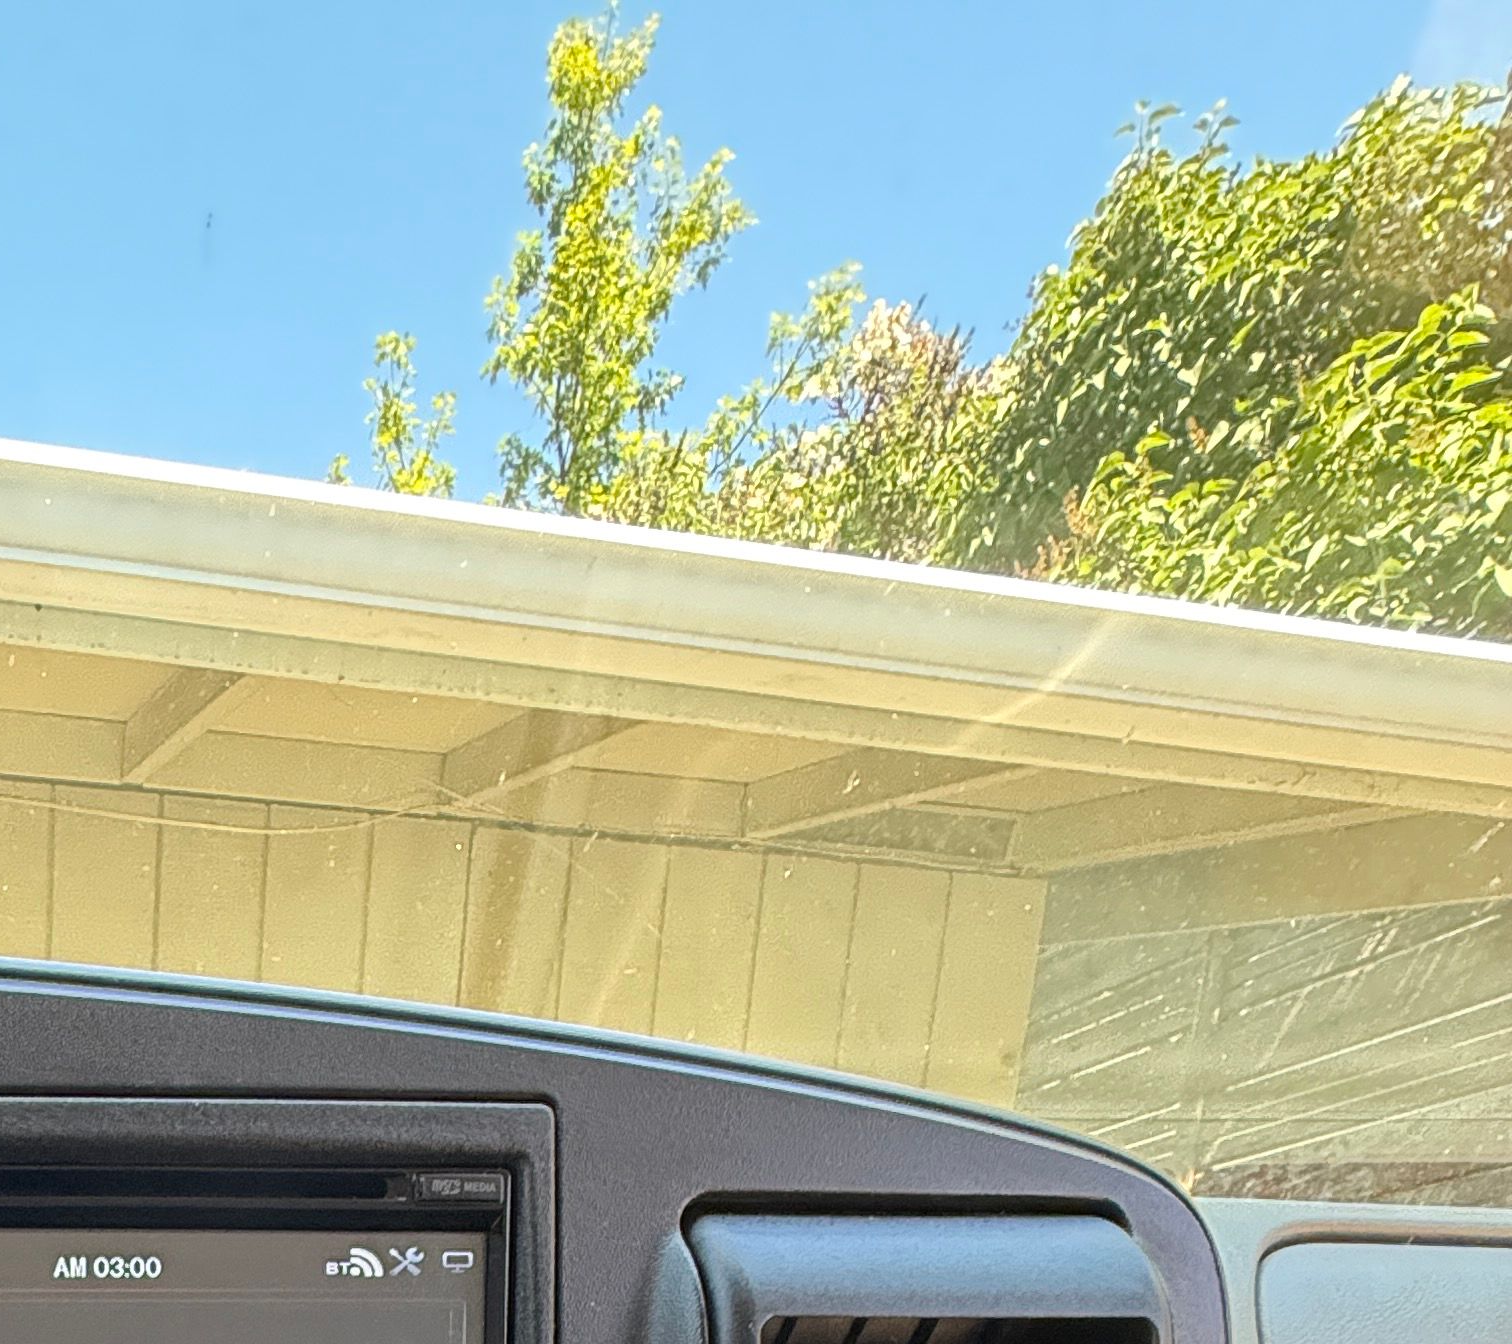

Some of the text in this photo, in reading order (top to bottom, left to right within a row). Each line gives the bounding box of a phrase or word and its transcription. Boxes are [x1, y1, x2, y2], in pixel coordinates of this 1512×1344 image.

[463, 1181, 496, 1193] MEDIA
[53, 1256, 162, 1278] AM 03:00
[325, 1261, 351, 1276] BT
